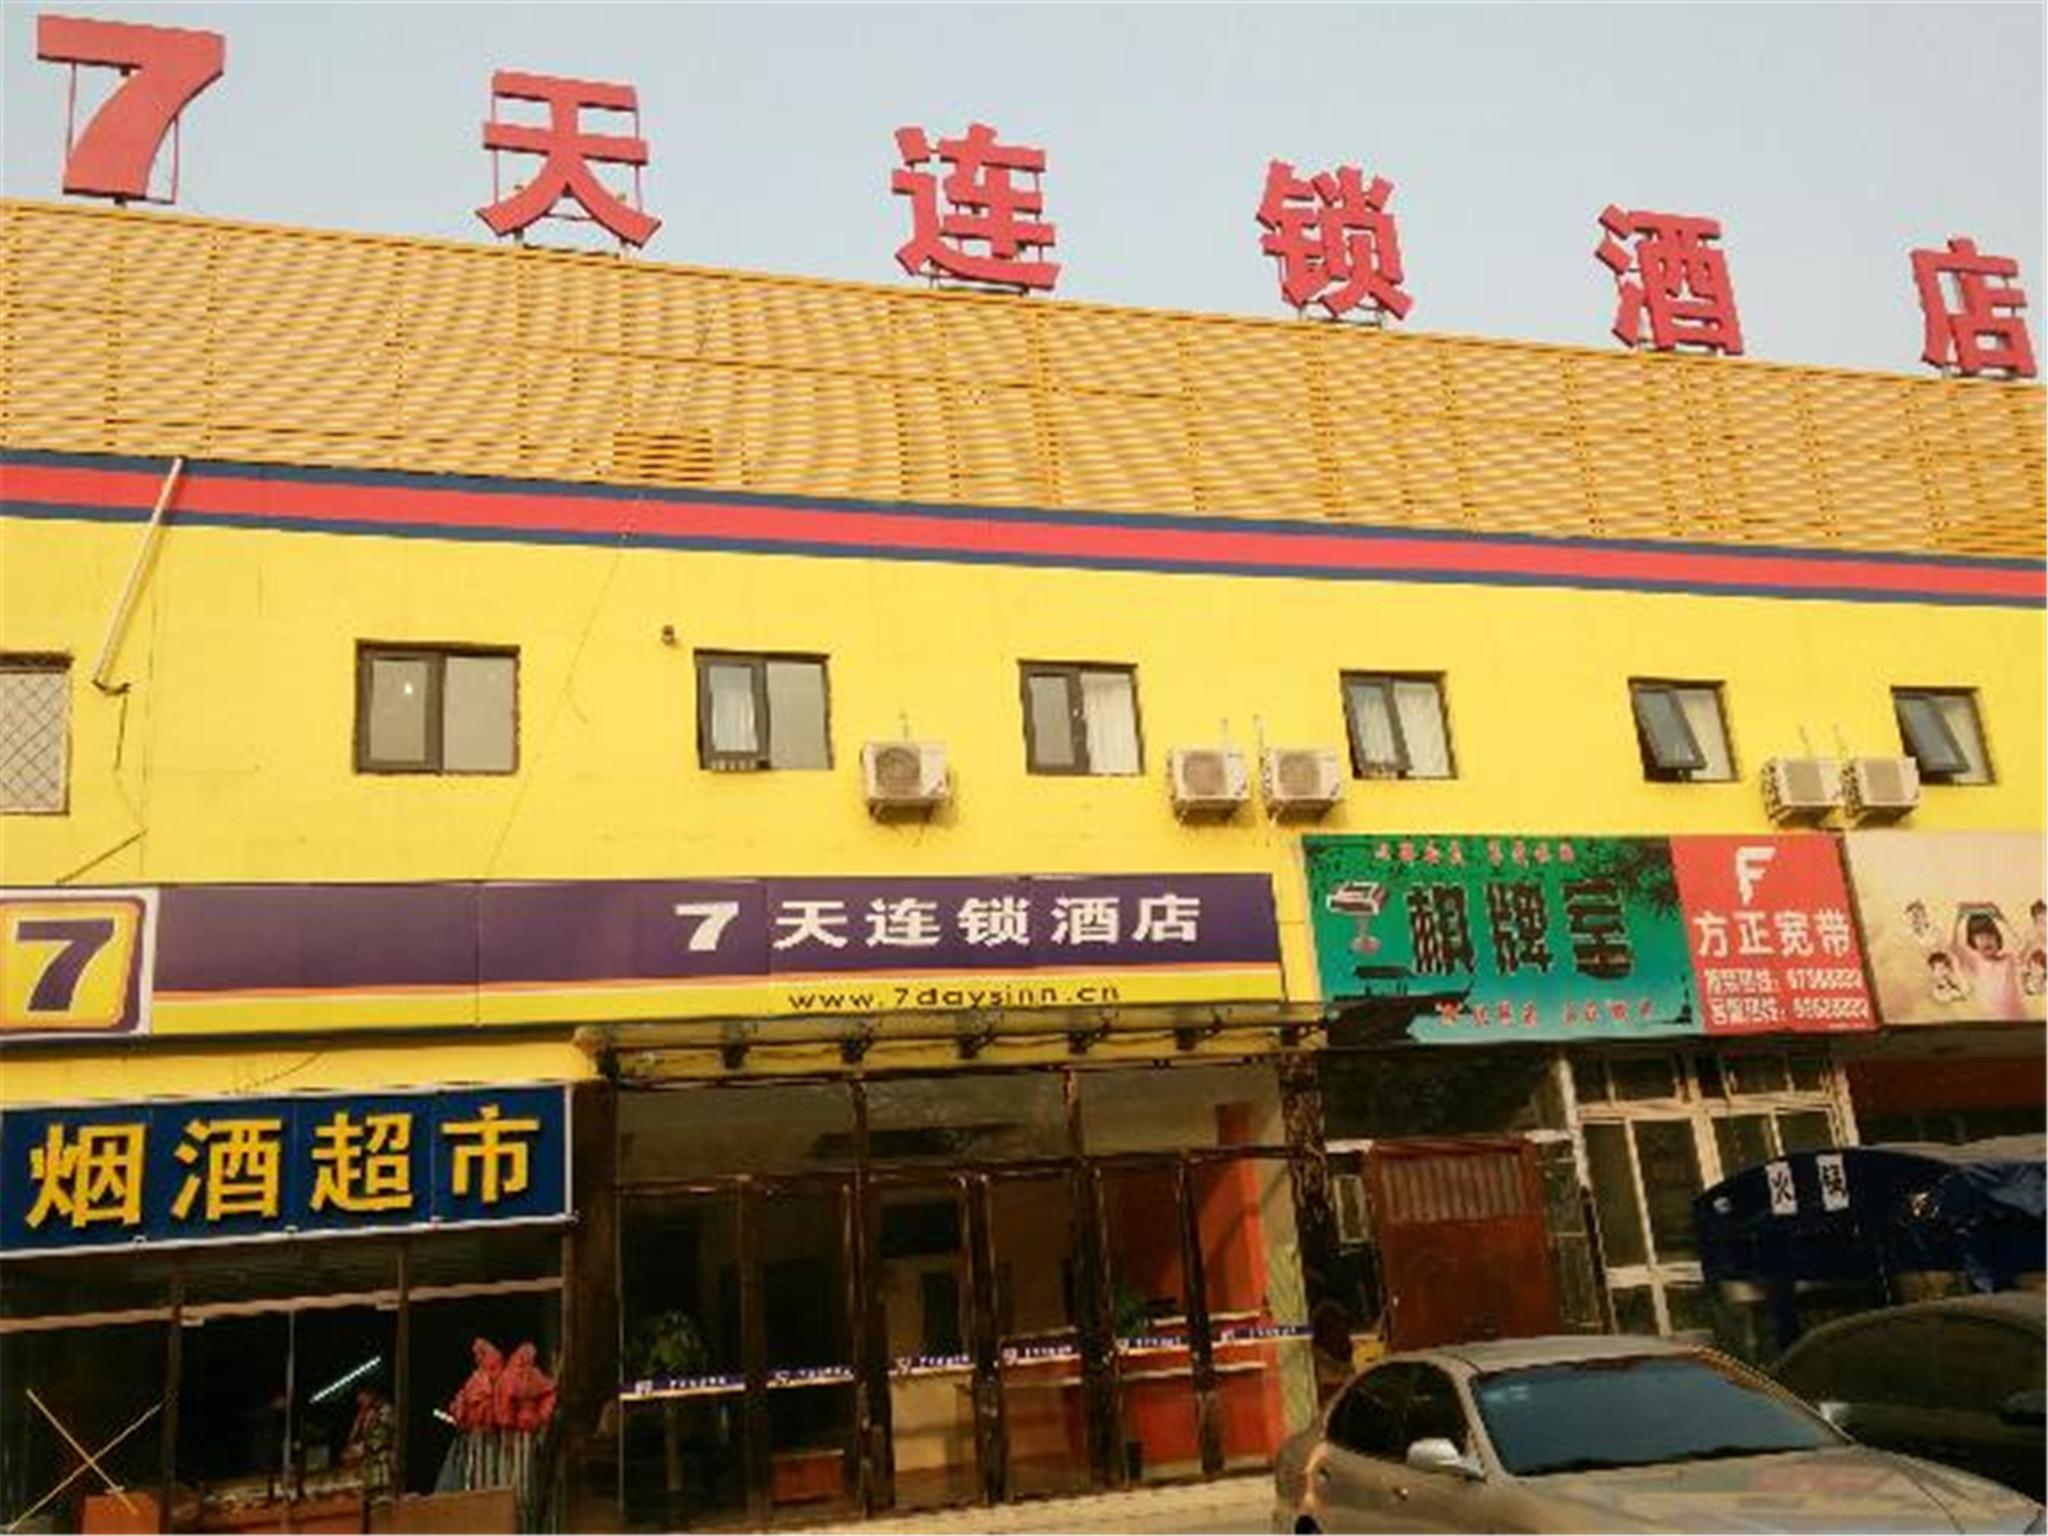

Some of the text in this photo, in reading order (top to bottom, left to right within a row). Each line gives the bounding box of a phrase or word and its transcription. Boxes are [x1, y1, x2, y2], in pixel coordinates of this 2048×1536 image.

[37, 15, 2037, 378] 7天连锁酒店
[675, 893, 1201, 951] 7天连锁酒店
[1695, 908, 1853, 958] 方正宽带
[16, 919, 115, 1012] 7
[788, 984, 1121, 1011] www.7daysinn.cn
[25, 1104, 542, 1229] 烟酒超市
